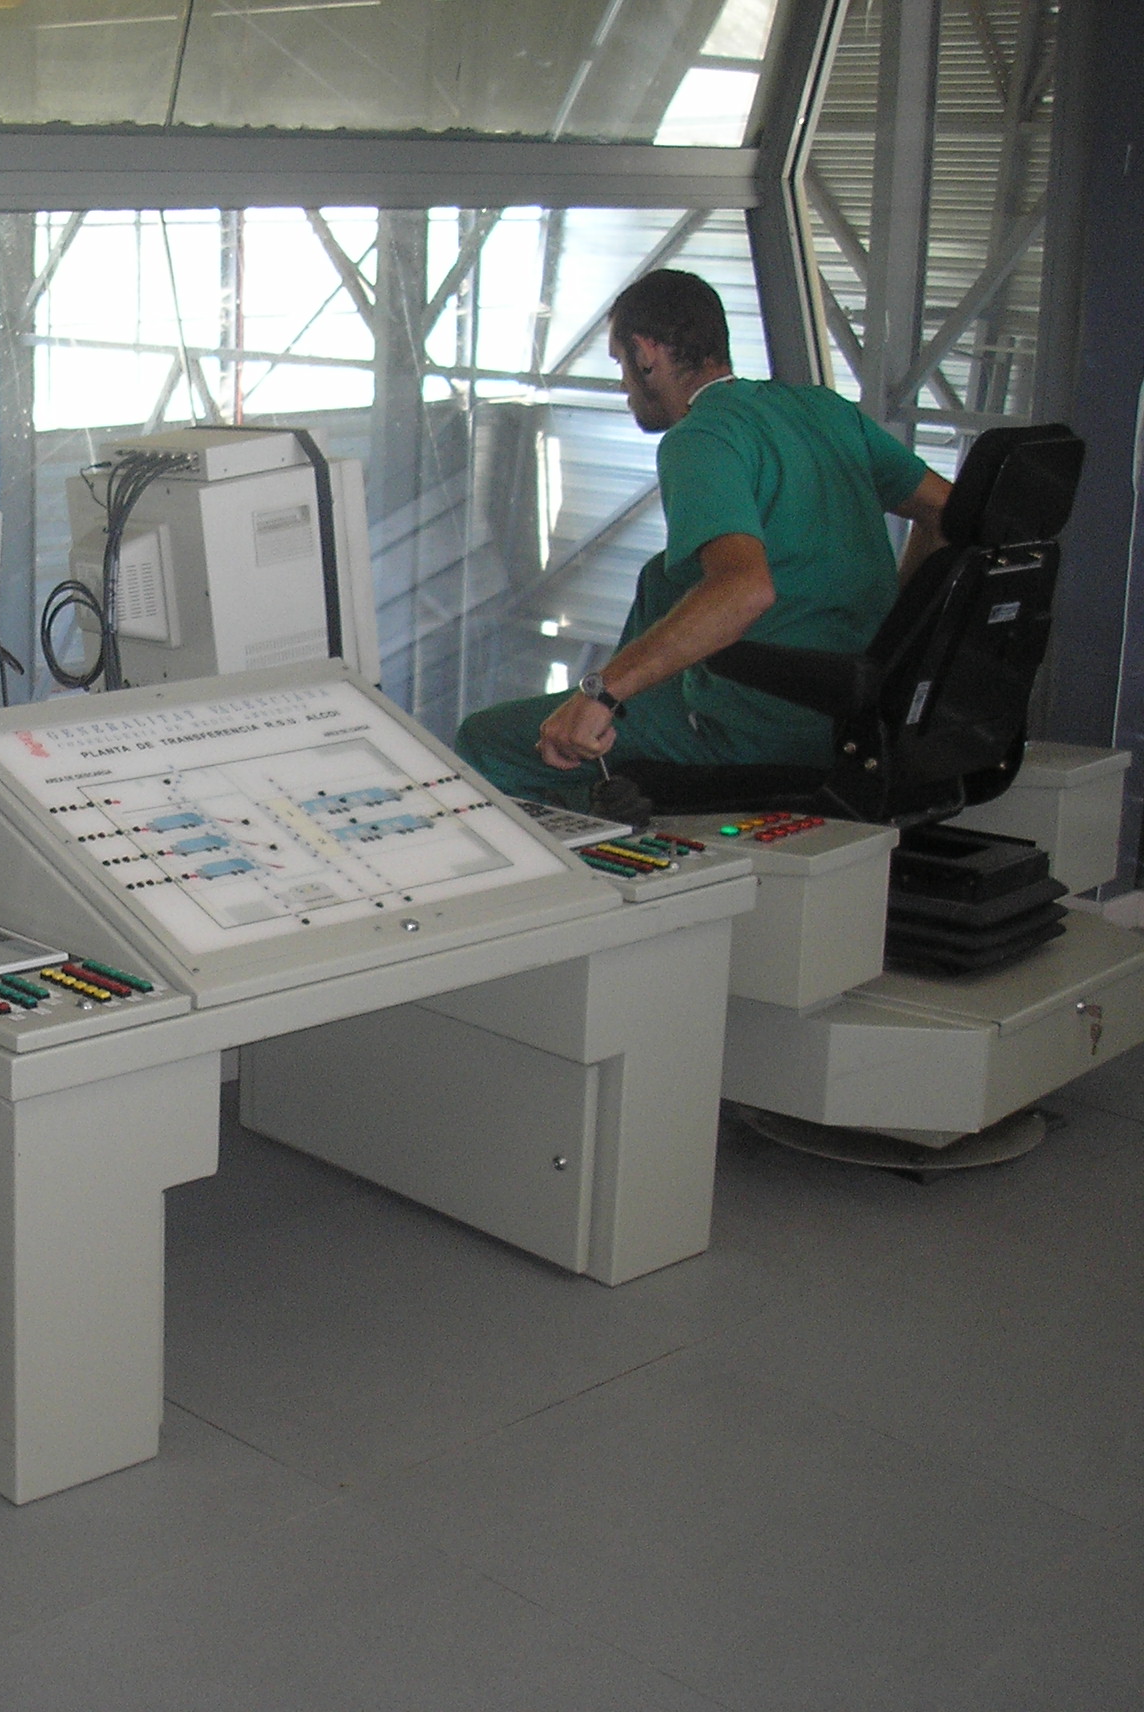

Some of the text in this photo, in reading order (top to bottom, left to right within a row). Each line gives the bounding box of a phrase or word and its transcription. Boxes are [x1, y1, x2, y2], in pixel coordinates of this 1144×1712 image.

[46, 709, 195, 741] GENERALITAT
[80, 745, 131, 759] PLANTA
[136, 741, 154, 750] DE
[160, 724, 260, 747] TRANSFERENCIA
